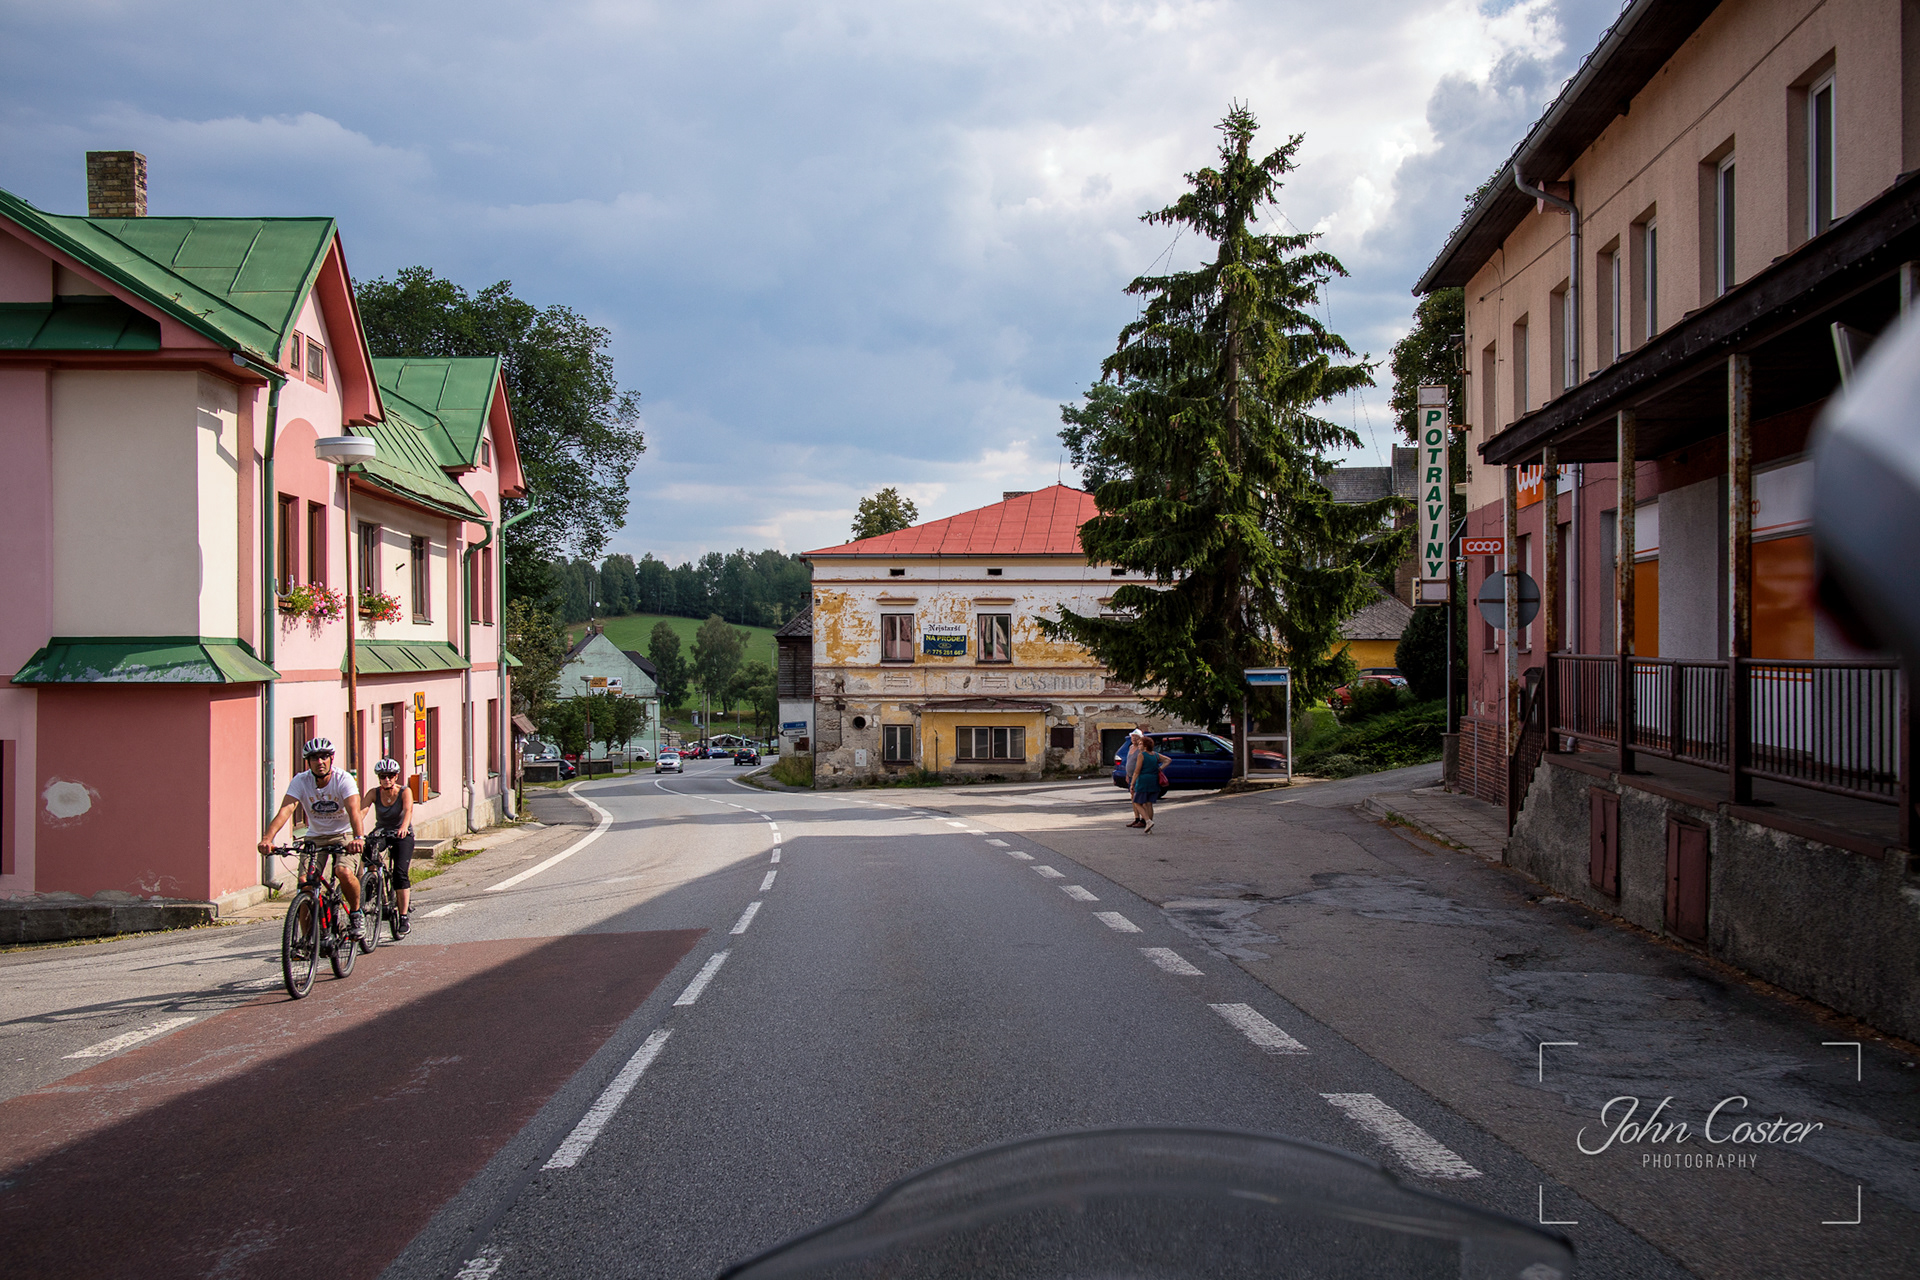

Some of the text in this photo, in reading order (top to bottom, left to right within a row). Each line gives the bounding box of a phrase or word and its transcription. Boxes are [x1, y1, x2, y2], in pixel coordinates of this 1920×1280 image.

[1425, 410, 1444, 577] POTRAVINY
[1466, 540, 1502, 554] coop
[925, 634, 965, 643] NA PRODEJ
